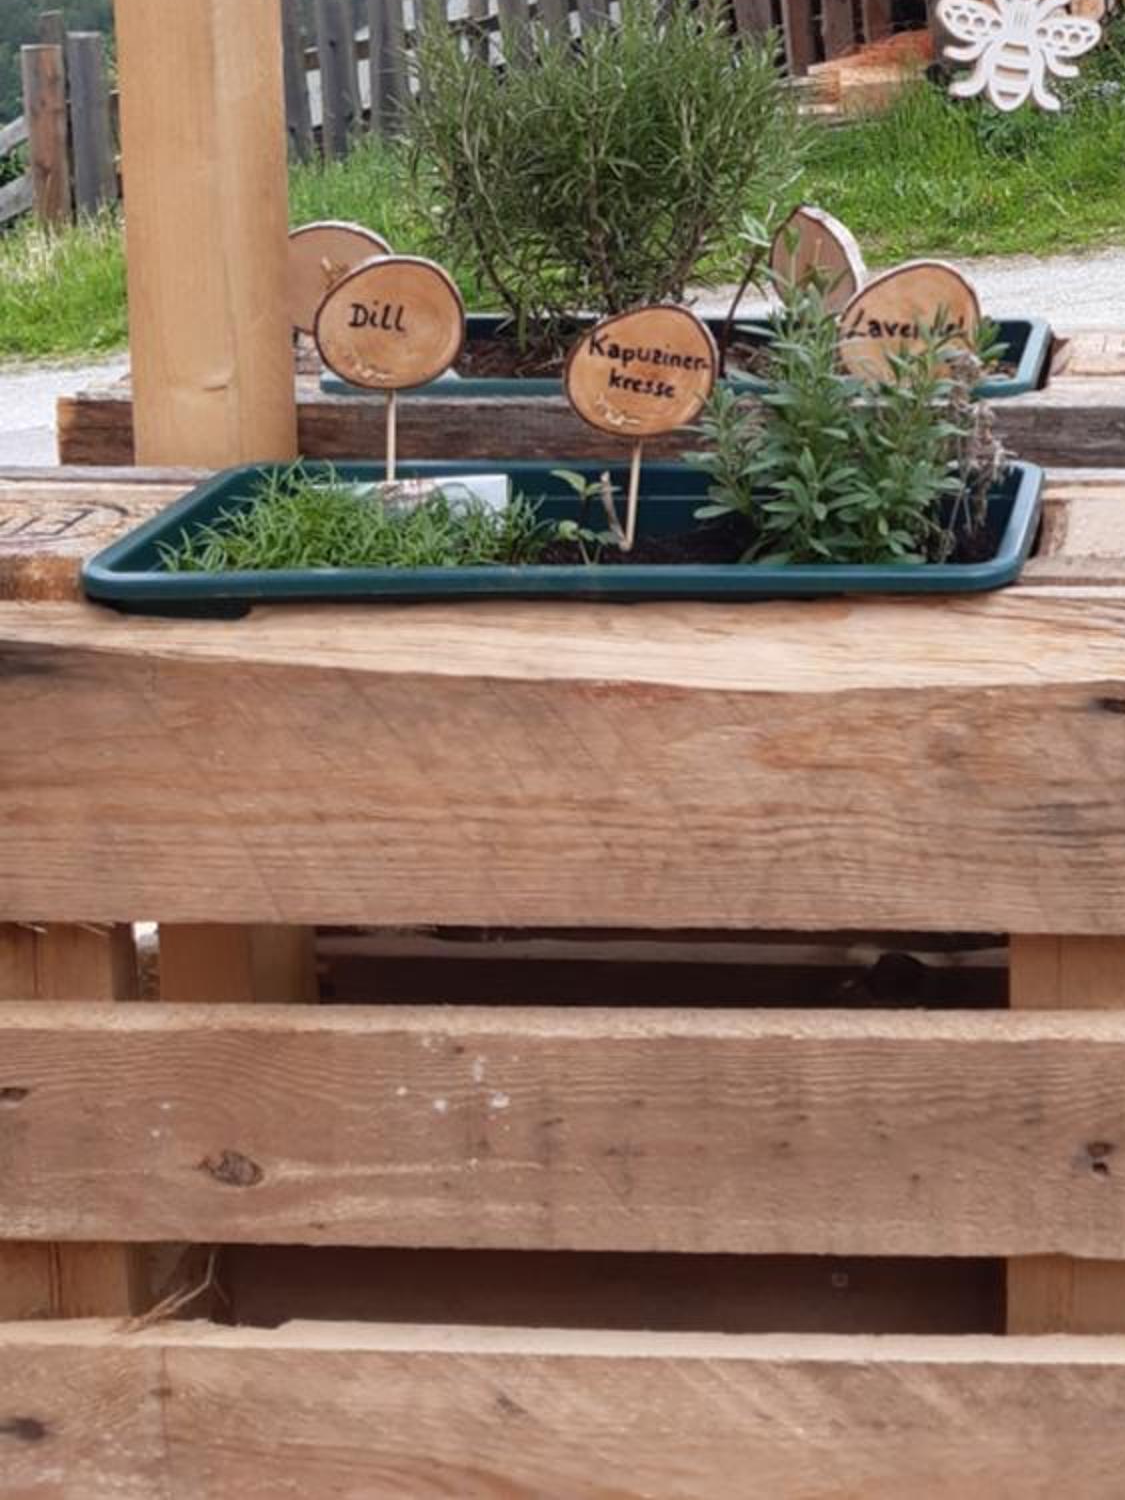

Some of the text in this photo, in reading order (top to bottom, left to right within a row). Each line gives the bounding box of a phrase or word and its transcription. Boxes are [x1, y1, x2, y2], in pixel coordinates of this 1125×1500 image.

[348, 300, 405, 333] Dill
[588, 331, 710, 371] Kapuziner-
[608, 367, 675, 398] kresse
